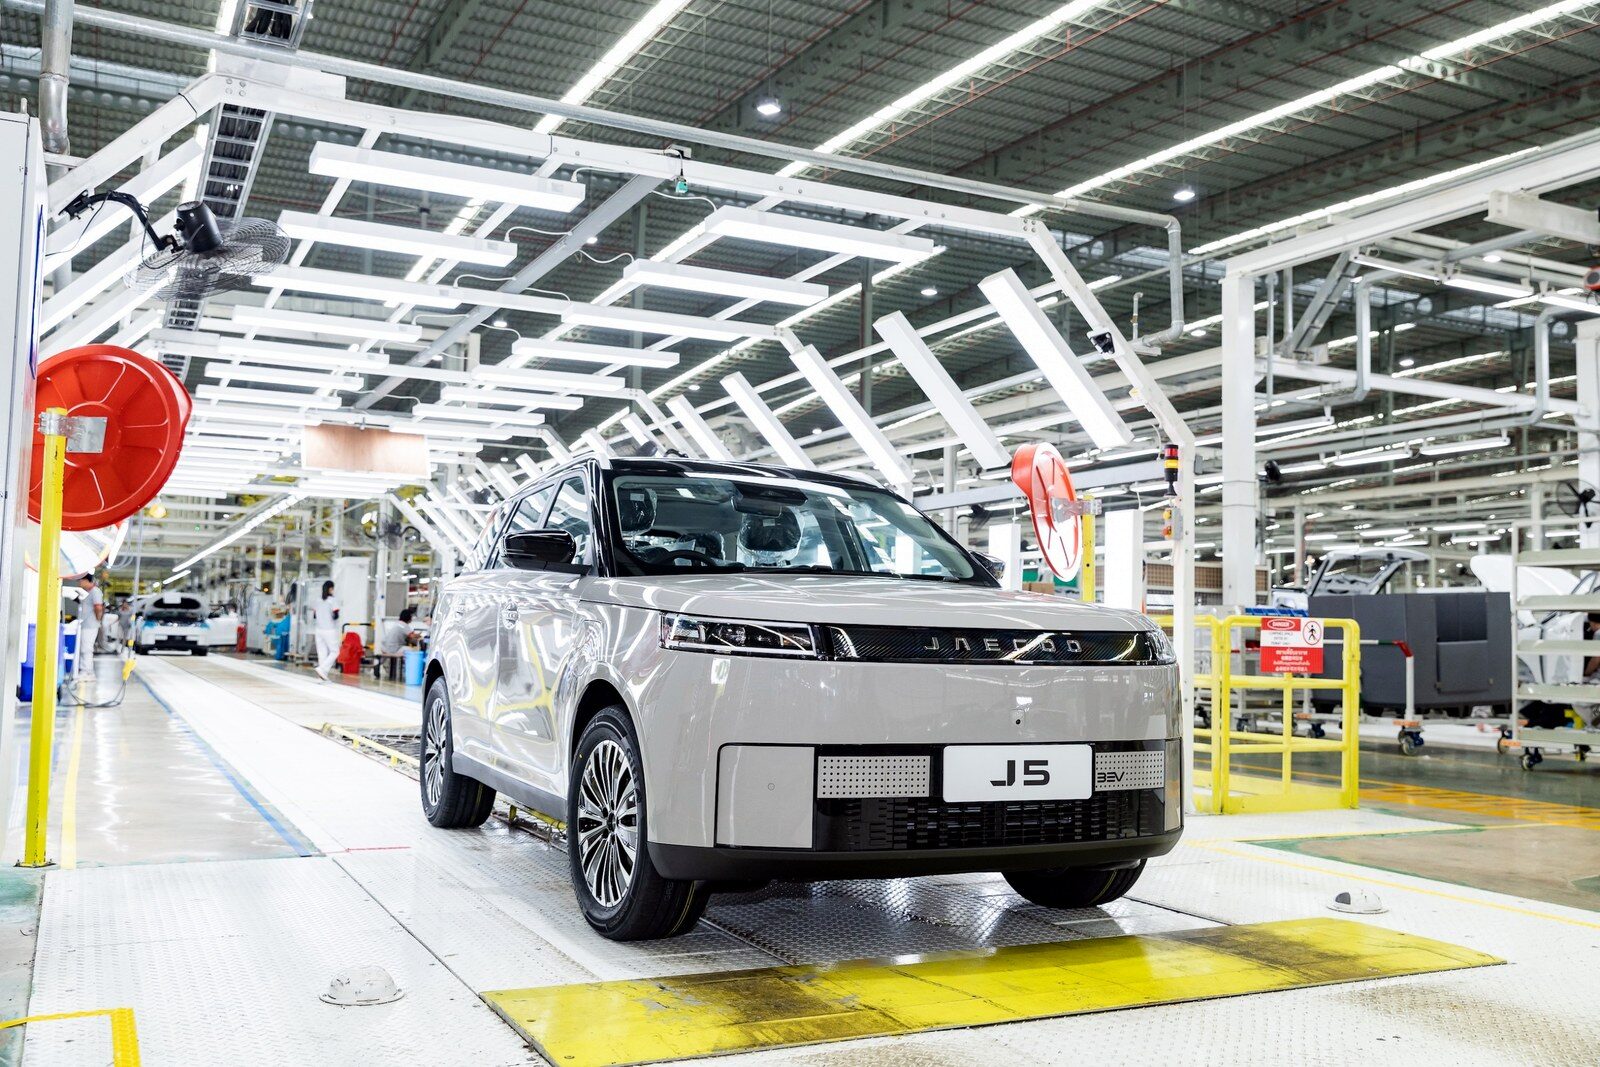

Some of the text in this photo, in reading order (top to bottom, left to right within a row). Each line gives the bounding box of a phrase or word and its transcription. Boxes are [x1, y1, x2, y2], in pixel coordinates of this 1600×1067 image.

[924, 636, 1083, 653] JAECOO
[990, 759, 1051, 787] J5
[1097, 771, 1126, 783] BEV
